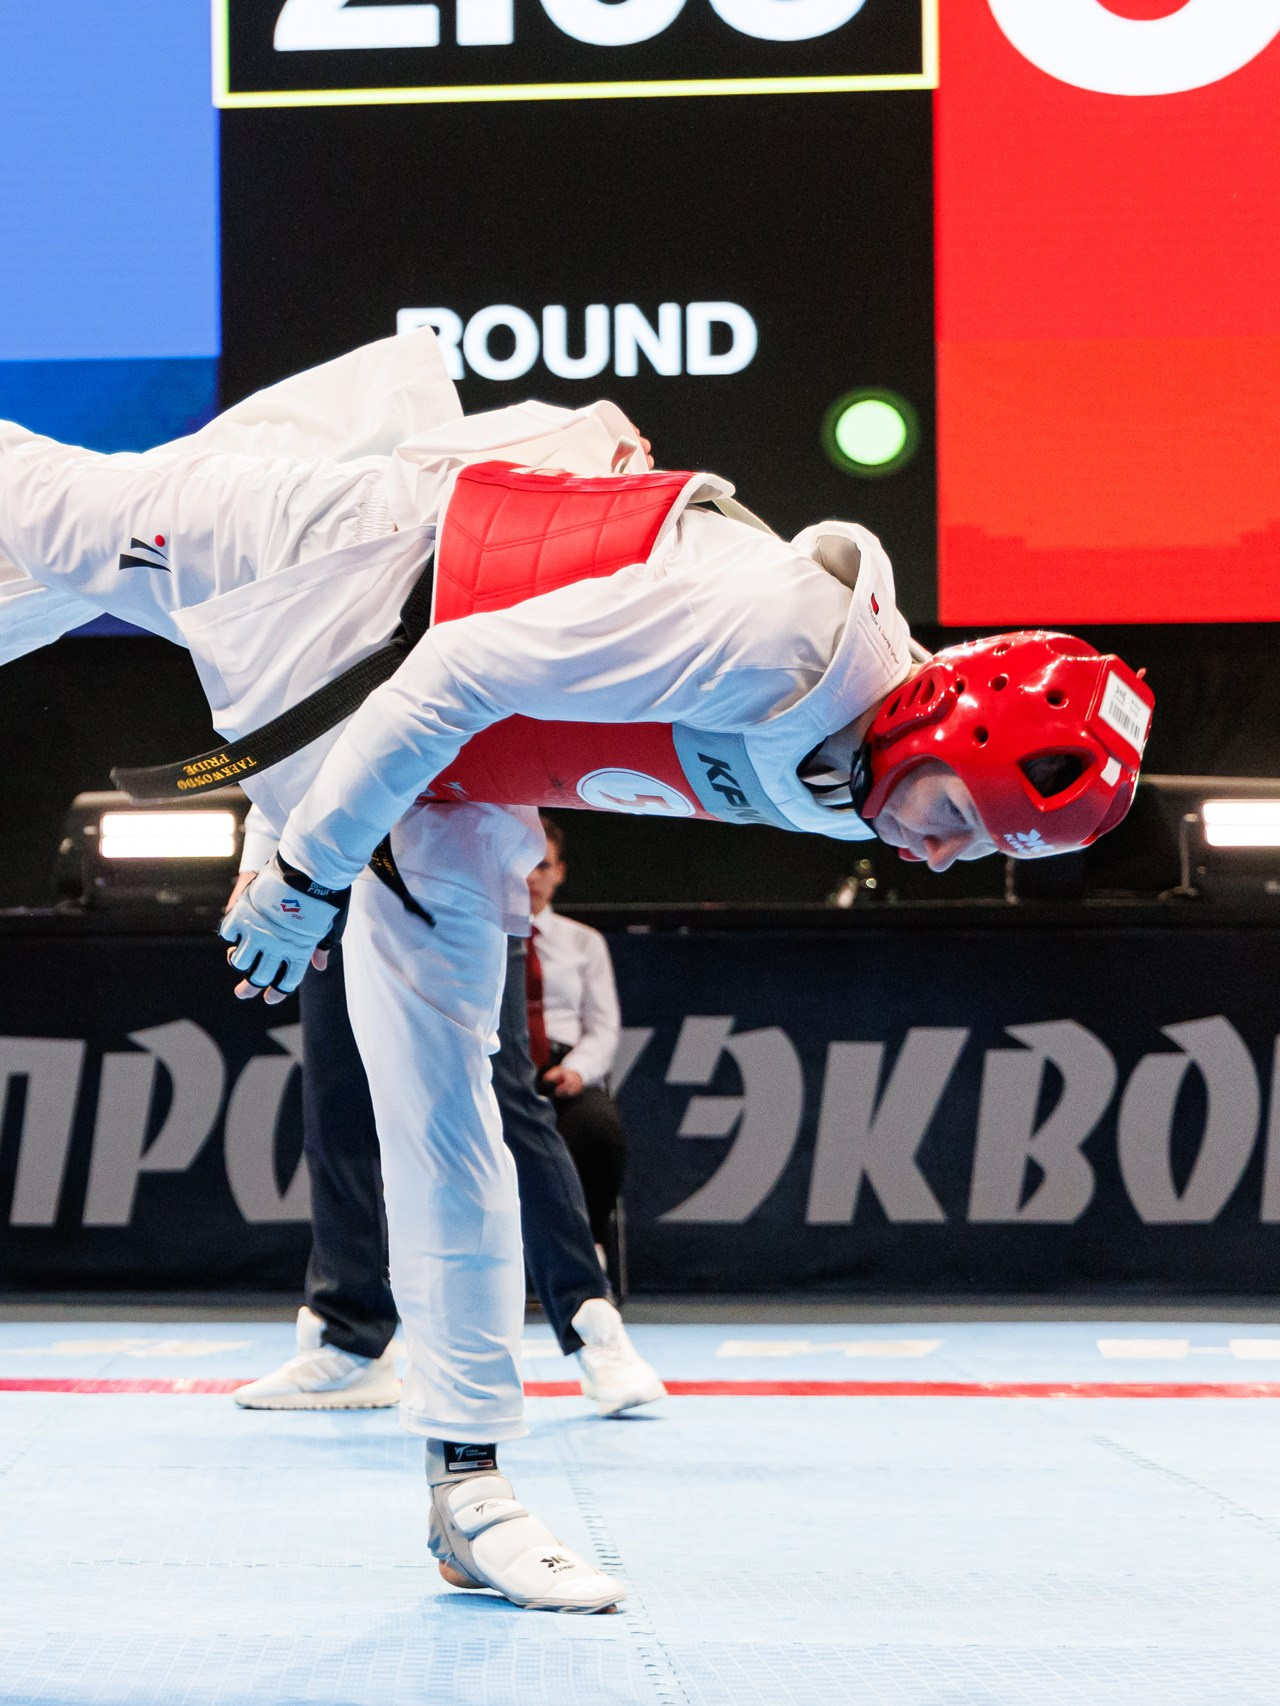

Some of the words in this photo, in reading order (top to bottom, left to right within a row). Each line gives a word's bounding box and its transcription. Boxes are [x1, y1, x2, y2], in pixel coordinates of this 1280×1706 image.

[397, 301, 759, 381] ROUND
[177, 756, 257, 791] TAEKWONDO
[182, 753, 230, 776] PRIDE
[597, 790, 674, 810] 5
